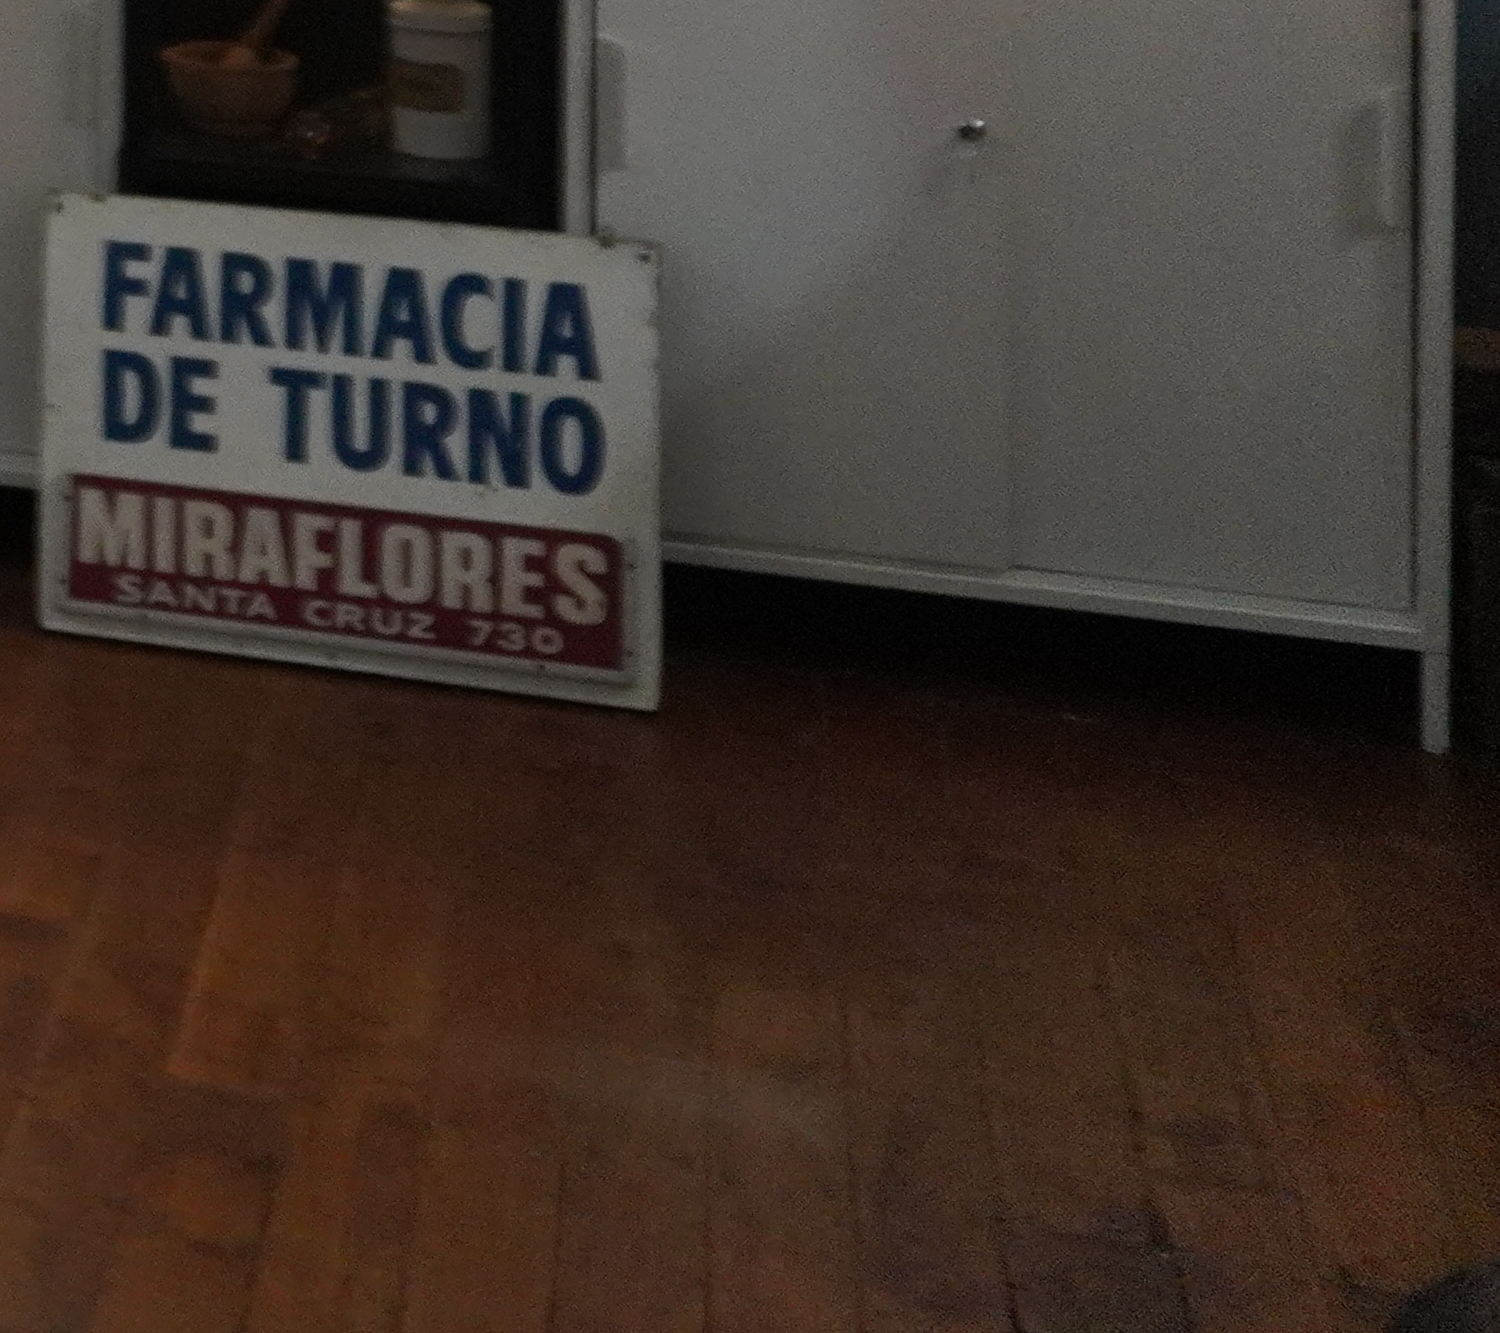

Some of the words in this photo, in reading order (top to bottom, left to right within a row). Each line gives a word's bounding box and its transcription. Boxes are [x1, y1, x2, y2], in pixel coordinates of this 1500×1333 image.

[101, 239, 601, 382] FARMACIA
[100, 347, 220, 454] DE
[266, 365, 609, 497] TURNO
[73, 484, 609, 626] MIRAFLORES
[113, 573, 277, 622] SANTA
[302, 597, 437, 641] CRUZ
[470, 617, 565, 657] 730
